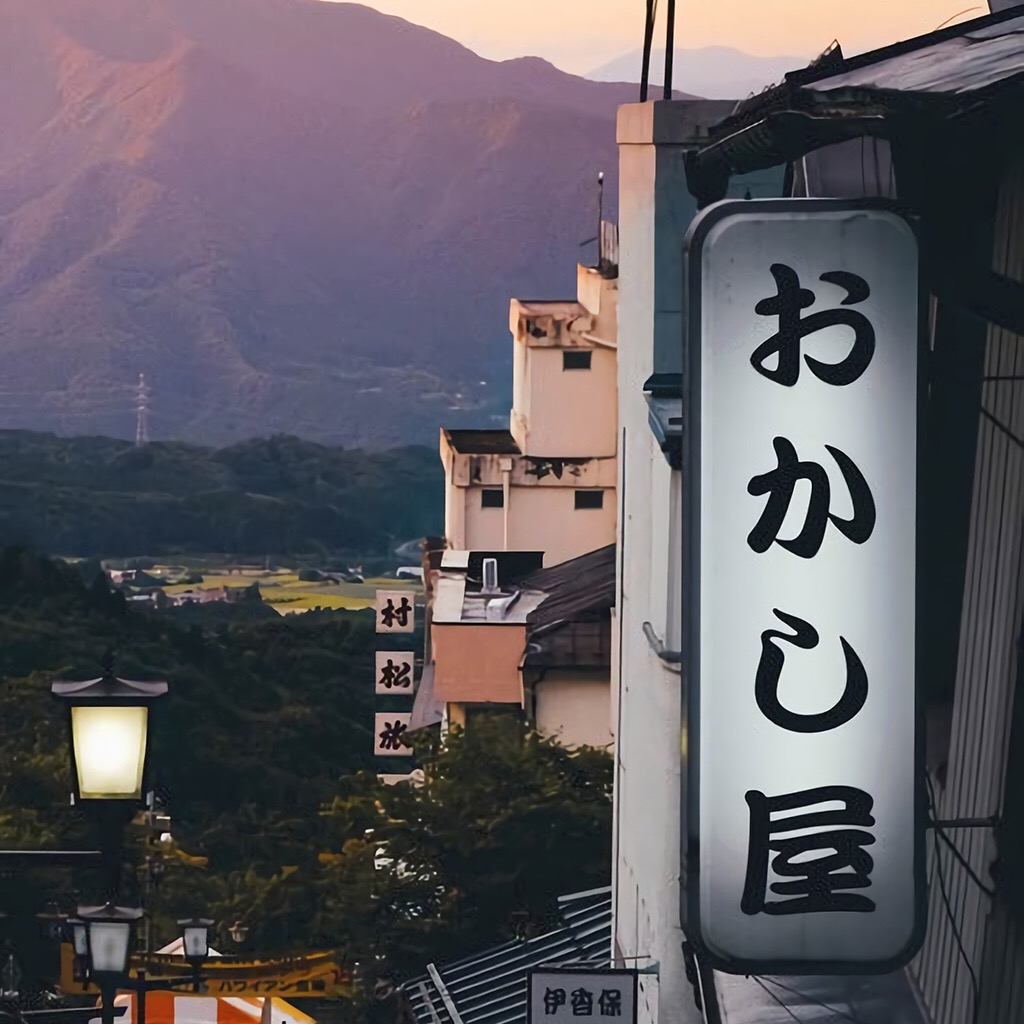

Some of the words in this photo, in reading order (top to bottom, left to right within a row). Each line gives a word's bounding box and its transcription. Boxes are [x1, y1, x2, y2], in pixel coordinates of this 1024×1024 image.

[740, 263, 876, 916] おかし屋
[543, 987, 622, 1017] 伊香保
